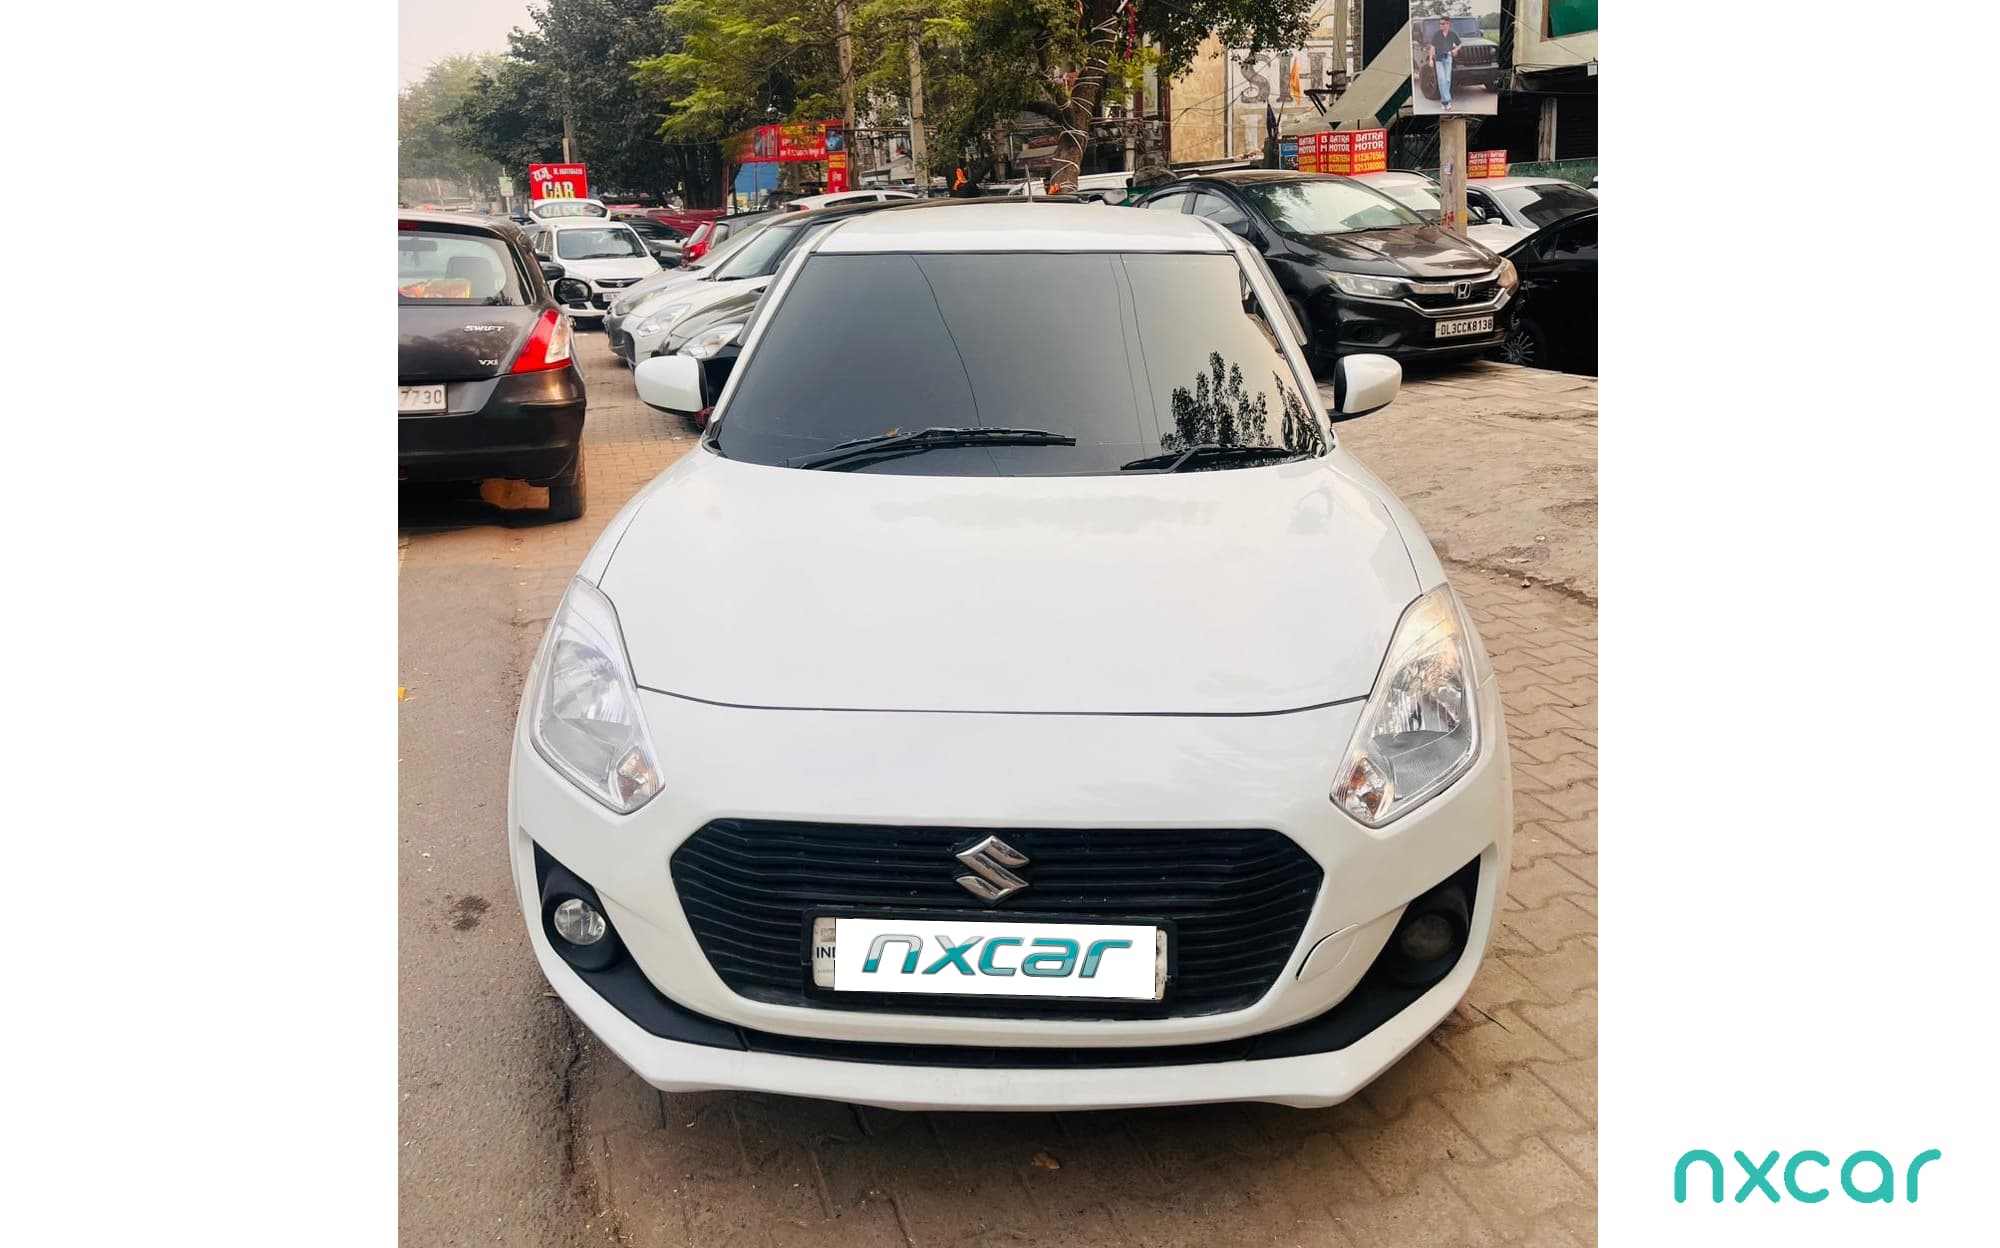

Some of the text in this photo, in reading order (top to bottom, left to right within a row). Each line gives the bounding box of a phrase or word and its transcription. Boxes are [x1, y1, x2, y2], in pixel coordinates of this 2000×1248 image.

[1329, 134, 1350, 144] BATRA
[1355, 131, 1384, 143] BATRA
[1328, 143, 1350, 153] MOTOR
[1354, 141, 1384, 152] MOTOR
[542, 181, 576, 199] CAR
[464, 325, 505, 333] SWIFT
